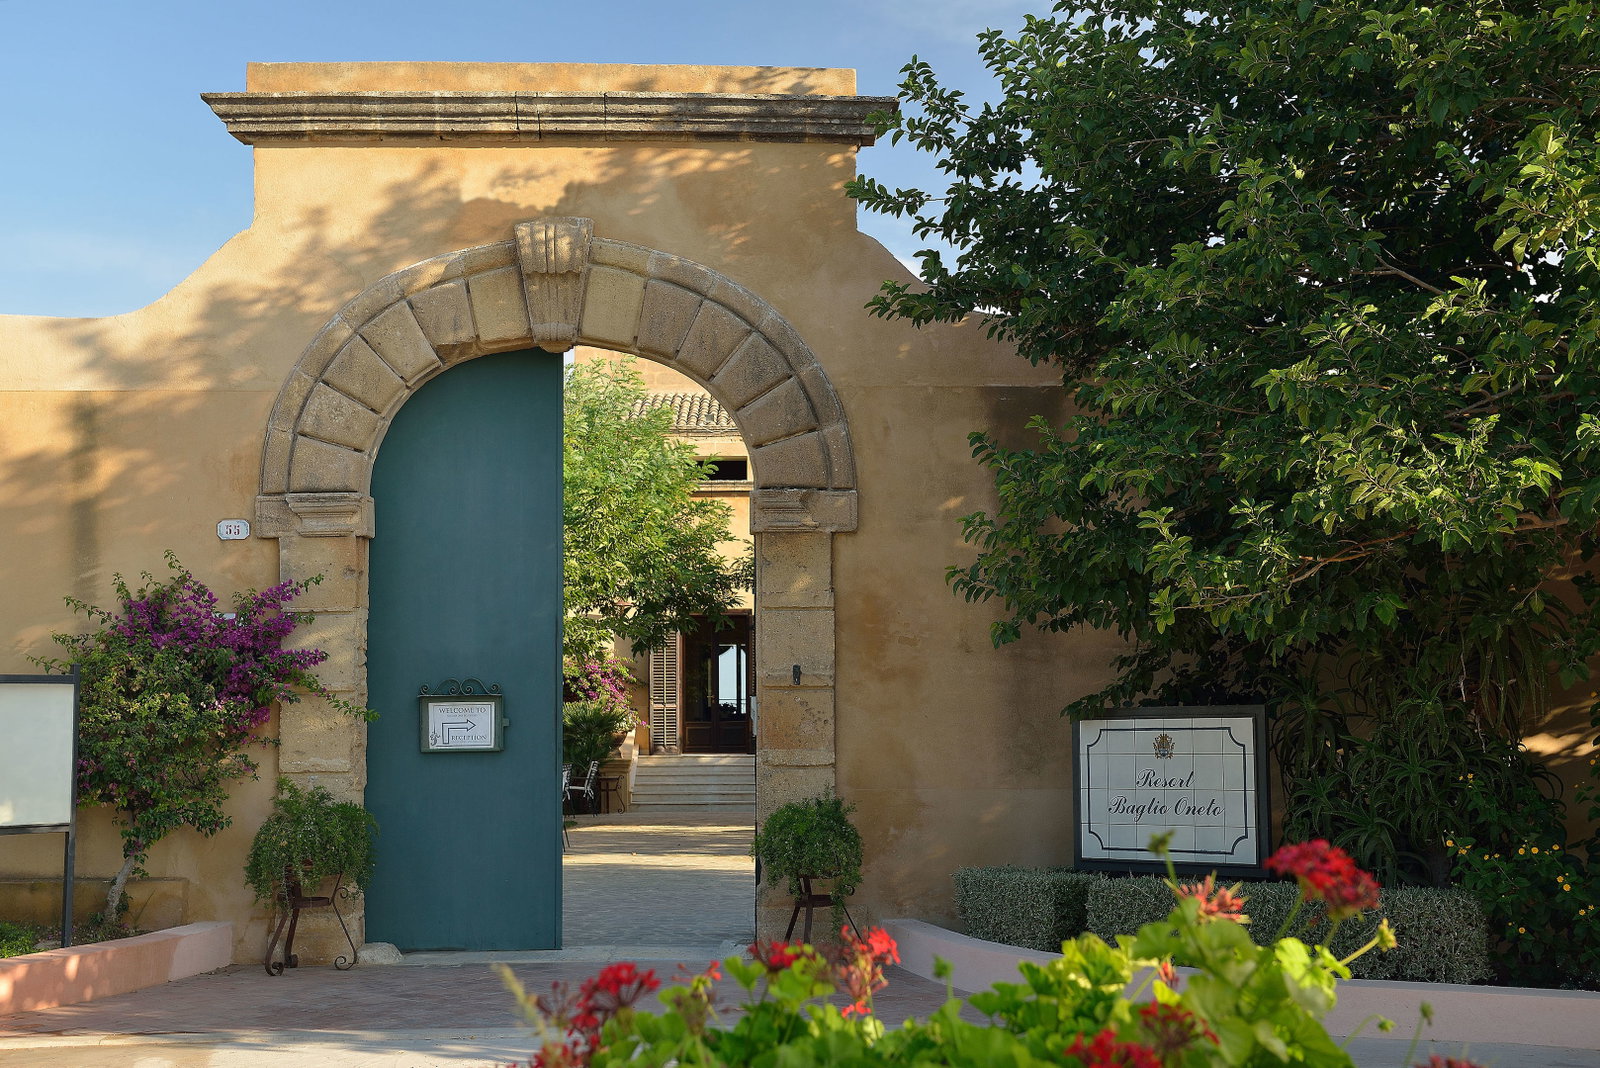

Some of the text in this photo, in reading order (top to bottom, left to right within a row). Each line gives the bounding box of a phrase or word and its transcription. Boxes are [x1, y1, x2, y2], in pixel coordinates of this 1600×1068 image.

[225, 524, 240, 536] 55
[1136, 768, 1195, 788] Resort
[1108, 795, 1225, 823] Baglio Oneto
